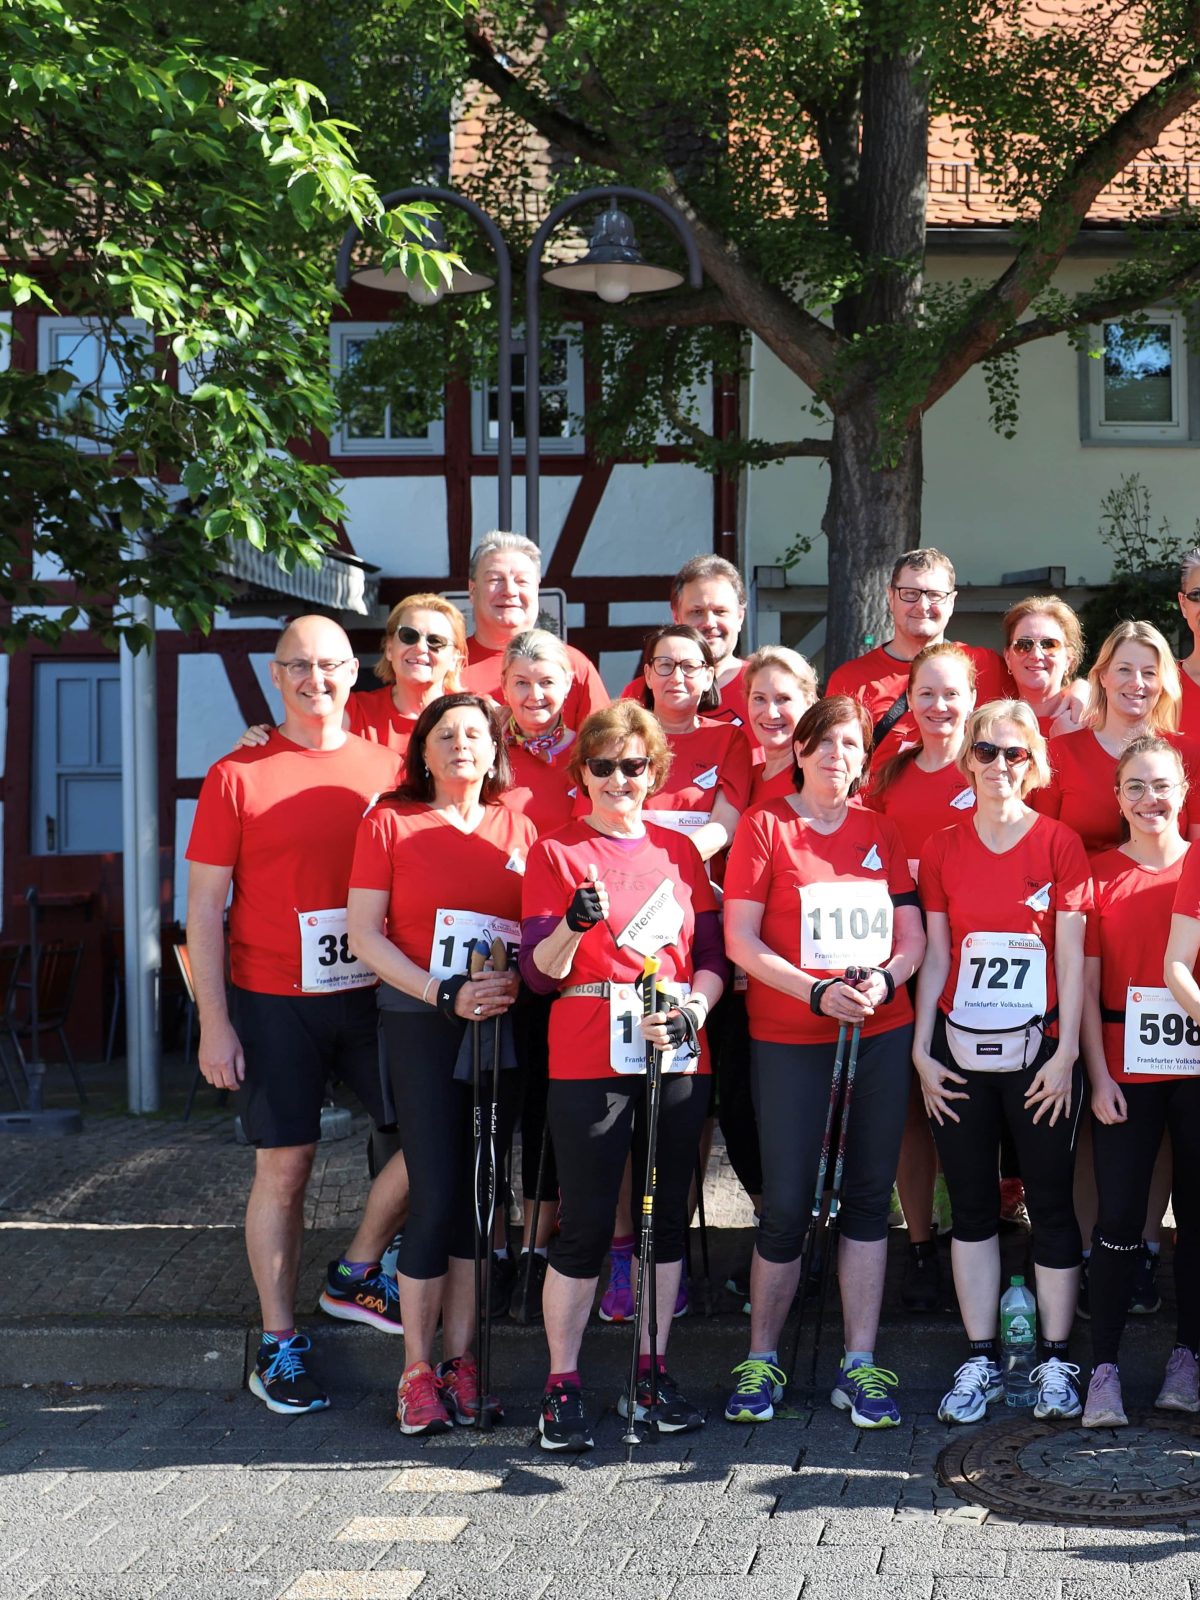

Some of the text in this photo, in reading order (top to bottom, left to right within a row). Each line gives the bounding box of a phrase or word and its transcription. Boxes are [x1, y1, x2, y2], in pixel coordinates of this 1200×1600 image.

[627, 892, 669, 941] Altenhain
[807, 907, 889, 941] 1104
[969, 957, 1031, 990] 727
[964, 1000, 998, 1008] Frankfurter
[1136, 1056, 1173, 1064] Frankfurter
